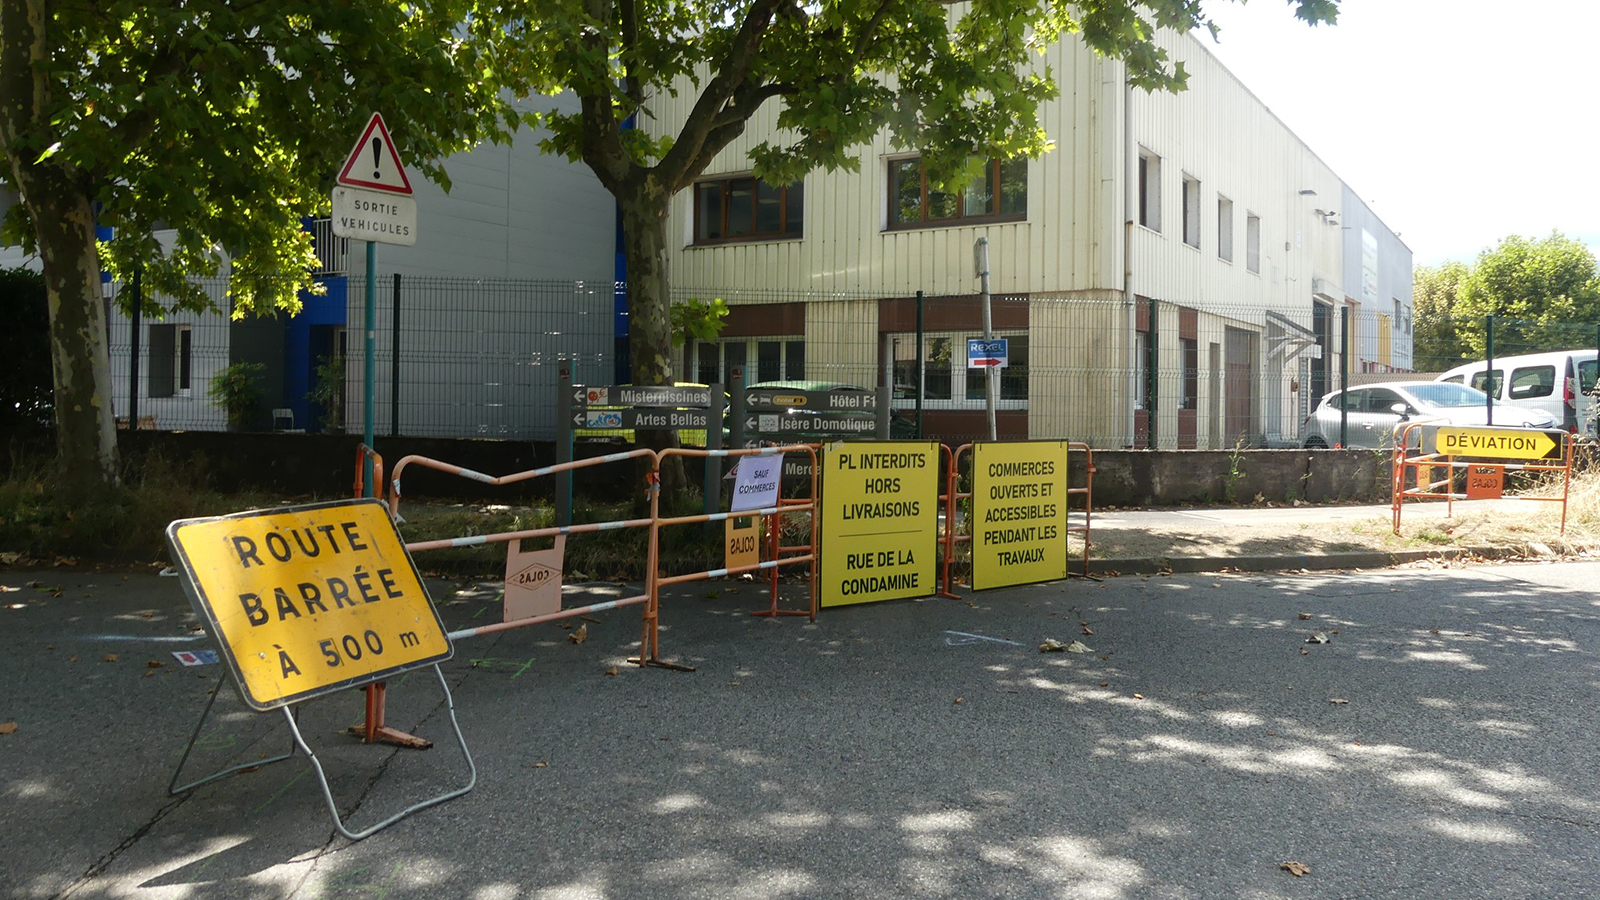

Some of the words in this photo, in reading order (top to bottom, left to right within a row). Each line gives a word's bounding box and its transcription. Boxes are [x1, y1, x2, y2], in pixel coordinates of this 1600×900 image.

[354, 200, 398, 216] SORTIE
[341, 217, 409, 236] VEHICULES
[620, 390, 707, 405] Misterpiscines
[829, 395, 859, 408] Hôtel
[863, 395, 876, 408] F1
[635, 413, 667, 426] Artes
[670, 413, 707, 426] Bellas
[781, 417, 810, 430] Isère
[813, 417, 875, 432] Domotique
[1446, 432, 1536, 451] DÉVIATION
[839, 454, 857, 470] PL
[860, 453, 926, 470] INTERDITS
[988, 461, 1055, 478] COMMERCES
[753, 469, 770, 479] SAUF
[738, 481, 776, 494] COMMERCES
[865, 478, 901, 494] HORS
[989, 483, 1038, 500] OUVERTS
[1041, 482, 1053, 497] ET
[843, 501, 920, 520] LIVRAISONS
[985, 504, 1056, 523] ACCESSIBLES
[984, 527, 1037, 546] PENDANT
[1037, 525, 1057, 541] LES
[231, 521, 369, 569] ROUTE
[847, 553, 874, 570] RUE
[877, 551, 895, 568] DE
[898, 549, 915, 565] LA
[997, 547, 1045, 567] TRAVAUX
[841, 573, 919, 596] CONDAMINE
[238, 565, 404, 628] BARRÉE
[273, 644, 302, 679] À
[319, 629, 384, 668] 500
[399, 630, 421, 648] m
